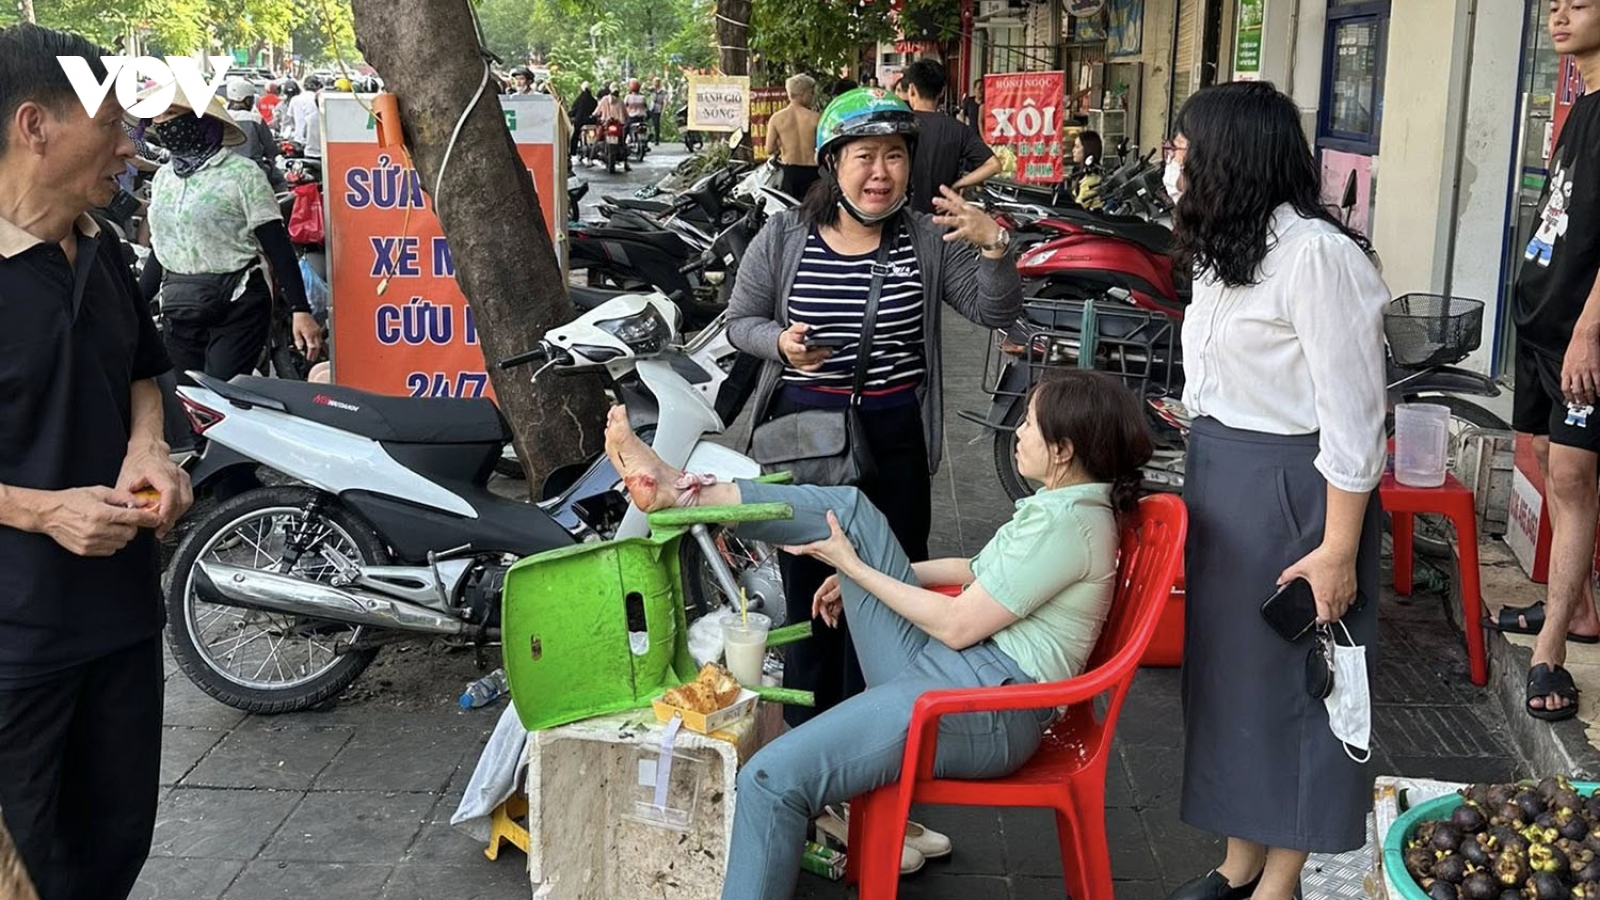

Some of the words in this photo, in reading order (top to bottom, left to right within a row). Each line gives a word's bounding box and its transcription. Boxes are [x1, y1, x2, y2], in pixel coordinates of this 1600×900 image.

[991, 97, 1056, 137] XÔI
[345, 153, 425, 209] SỬA
[369, 236, 421, 277] XE
[375, 297, 453, 345] CỨU
[406, 371, 489, 398] 24/7
